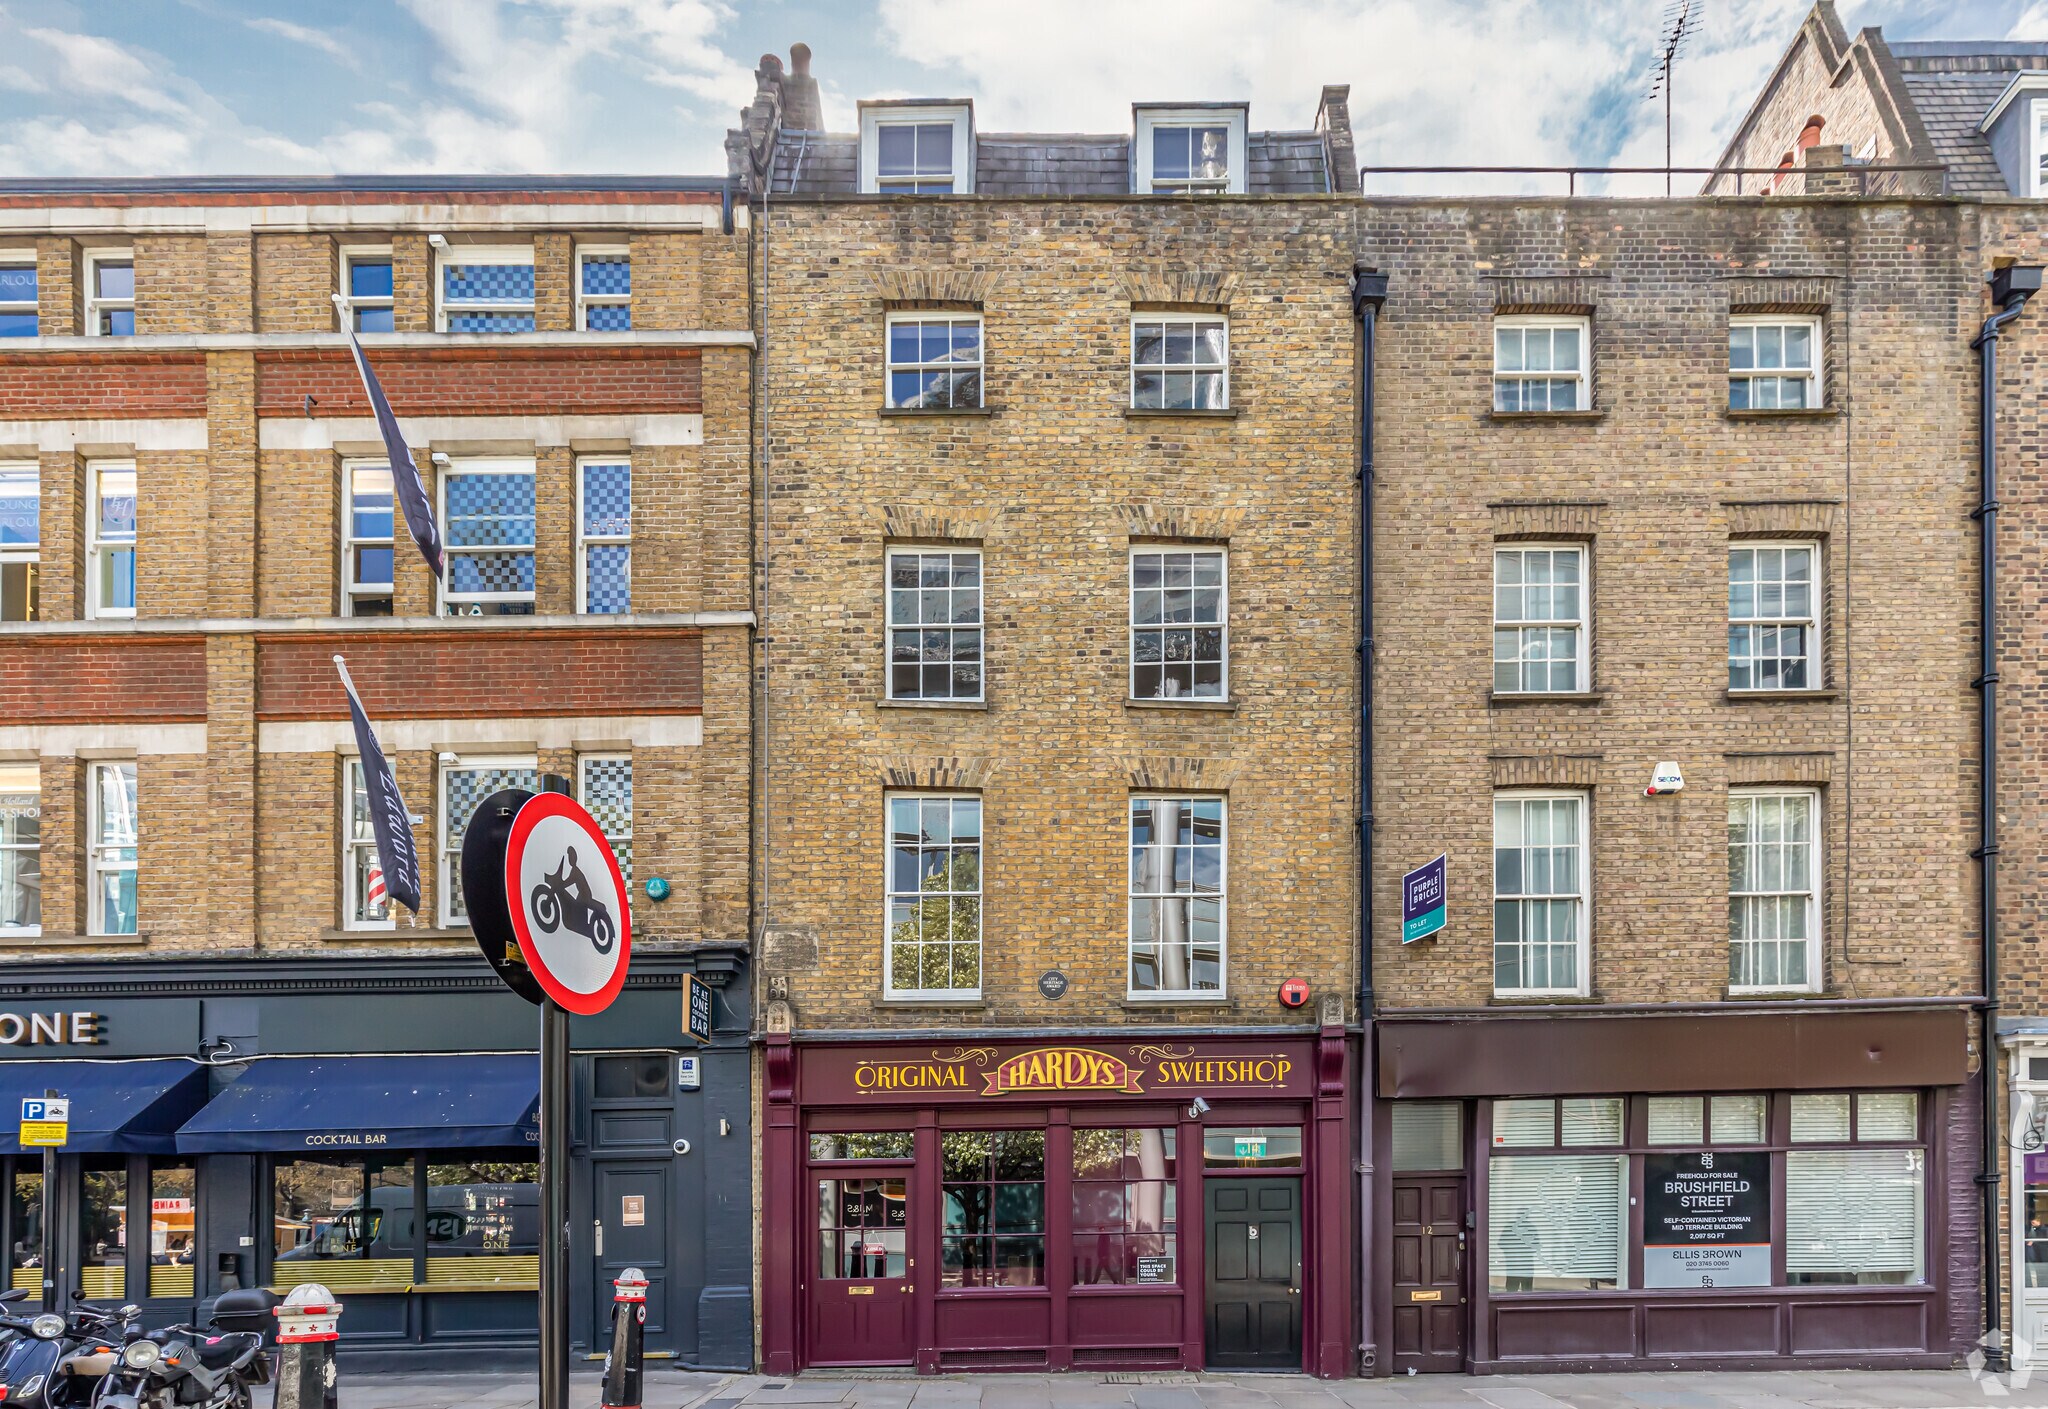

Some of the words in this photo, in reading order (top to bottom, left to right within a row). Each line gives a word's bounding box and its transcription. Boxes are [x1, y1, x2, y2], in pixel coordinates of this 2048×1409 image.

[3, 796, 35, 805] Holland
[1413, 875, 1438, 895] PURPLE
[1413, 885, 1438, 904] BRICKS
[1410, 922, 1418, 930] TO
[1418, 918, 1427, 927] LET
[692, 983, 700, 996] BE
[701, 989, 709, 1002] AT
[692, 996, 709, 1015] ONE
[0, 1012, 96, 1044] ONE
[692, 1015, 708, 1036] BAR
[854, 1065, 969, 1090] ORIGINAL
[1009, 1051, 1116, 1089] HARDYS
[1157, 1060, 1292, 1083] SWEETSHOP
[28, 1103, 42, 1118] P
[305, 1134, 362, 1146] COCKTAIL
[365, 1134, 387, 1144] BAR
[1664, 1181, 1751, 1194] BRUSHFIELD
[1681, 1195, 1734, 1208] STREET
[1422, 1225, 1433, 1235] 12
[1689, 1232, 1706, 1240] 2,097
[483, 1240, 510, 1249] ONE
